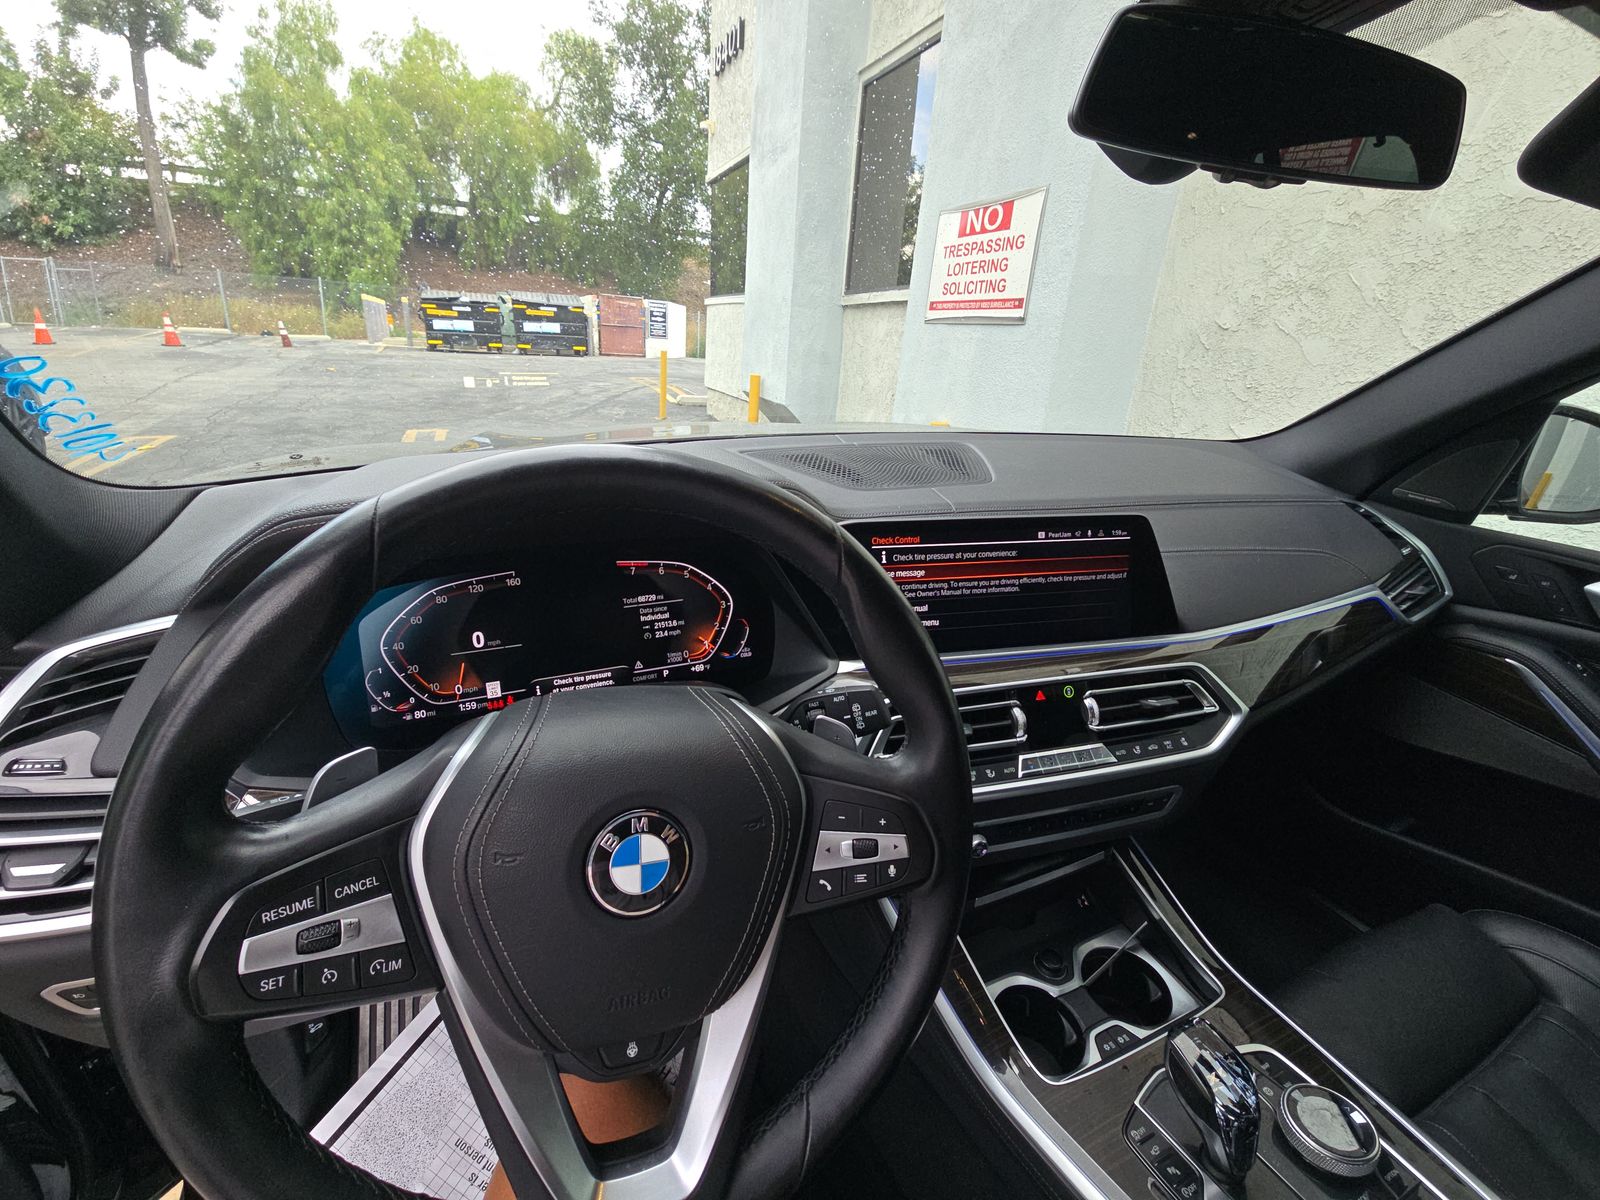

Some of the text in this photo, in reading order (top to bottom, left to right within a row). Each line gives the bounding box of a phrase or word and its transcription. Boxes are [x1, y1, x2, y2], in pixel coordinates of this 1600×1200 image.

[713, 16, 745, 76] 18401
[966, 204, 1004, 235] NO
[943, 234, 1026, 259] TRESPASSING
[946, 257, 1009, 277] LOITERING
[942, 278, 1007, 296] SOLICITING
[871, 536, 920, 545] Check Control
[892, 554, 914, 562] Check
[914, 553, 926, 561] tire
[926, 552, 954, 561] pressure
[963, 552, 977, 560] your
[978, 550, 1018, 558] convenience:
[630, 567, 636, 576] 7
[658, 567, 664, 575] 6
[684, 570, 690, 579] 5
[896, 569, 926, 578] message
[505, 577, 522, 586] 160
[902, 583, 927, 591] continue
[928, 582, 949, 590] driving.
[958, 580, 979, 588] ensure
[1000, 578, 1019, 586] driving
[1073, 574, 1096, 582] pressure
[468, 584, 484, 594] 120
[706, 583, 712, 592] 4
[916, 590, 940, 598] Owner's
[987, 586, 1020, 594] information.
[435, 595, 448, 604] 80
[638, 594, 656, 602] 68729
[720, 600, 726, 608] 3
[912, 604, 928, 612] nual
[640, 606, 652, 614] Data
[410, 616, 423, 624] 60
[640, 612, 670, 622] Individual
[654, 620, 678, 630] 21513.6
[714, 622, 720, 630] 2
[654, 629, 681, 638] 23.4 mph
[472, 631, 501, 648] 0 mph
[704, 640, 708, 649] 1
[392, 642, 404, 650] 40
[683, 650, 689, 658] 0
[407, 664, 419, 674] 20
[690, 664, 704, 672] +69
[553, 671, 612, 686] Check tire pressure
[632, 673, 658, 682] COMFORT
[428, 682, 440, 691] 10
[454, 684, 478, 694] 0 mph
[575, 679, 615, 690] convenience.
[458, 701, 488, 712] 1:59 pm
[414, 710, 427, 719] 80
[600, 816, 680, 853] BMW
[334, 876, 380, 899] CANCEL
[261, 896, 316, 924] RESUME
[382, 958, 402, 974] LIM
[260, 975, 285, 992] SET
[454, 1138, 486, 1164] person
[468, 1172, 479, 1186] is
